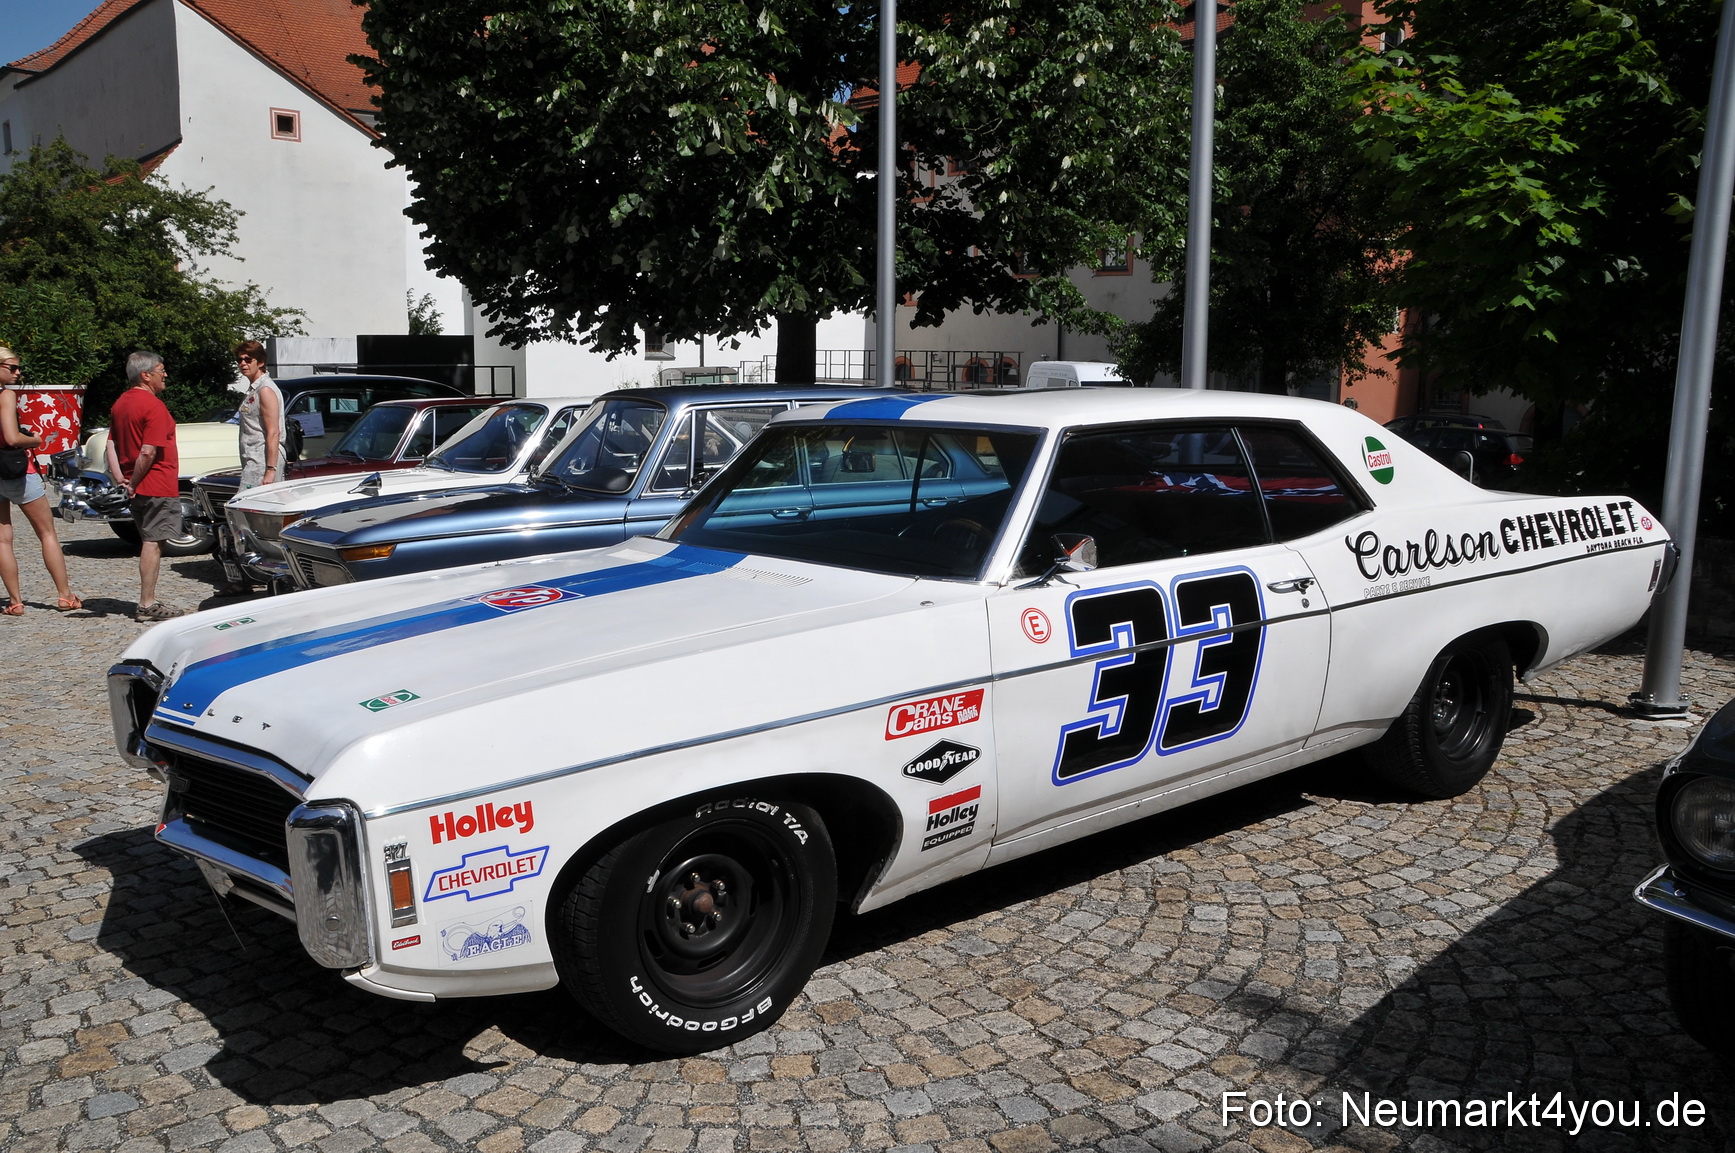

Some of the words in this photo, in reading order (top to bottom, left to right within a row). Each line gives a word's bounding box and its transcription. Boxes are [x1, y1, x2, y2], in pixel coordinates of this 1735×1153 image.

[1367, 452, 1392, 468] Castrol
[1345, 528, 1500, 582] Carlson
[1500, 501, 1638, 554] CHEVROLET
[1585, 541, 1613, 553] DAYTONA
[1613, 537, 1632, 549] BEACH
[1632, 536, 1644, 545] FLA
[1363, 584, 1391, 599] PARTS
[1399, 575, 1431, 592] SERVICE
[1028, 616, 1044, 636] E
[1052, 566, 1266, 785] 33
[888, 695, 966, 736] CRANE
[429, 801, 535, 845] Holley
[926, 803, 979, 832] Holley
[923, 825, 974, 848] EQUIPPED
[438, 855, 537, 892] CHEVROLET
[466, 934, 524, 958] EAGLE
